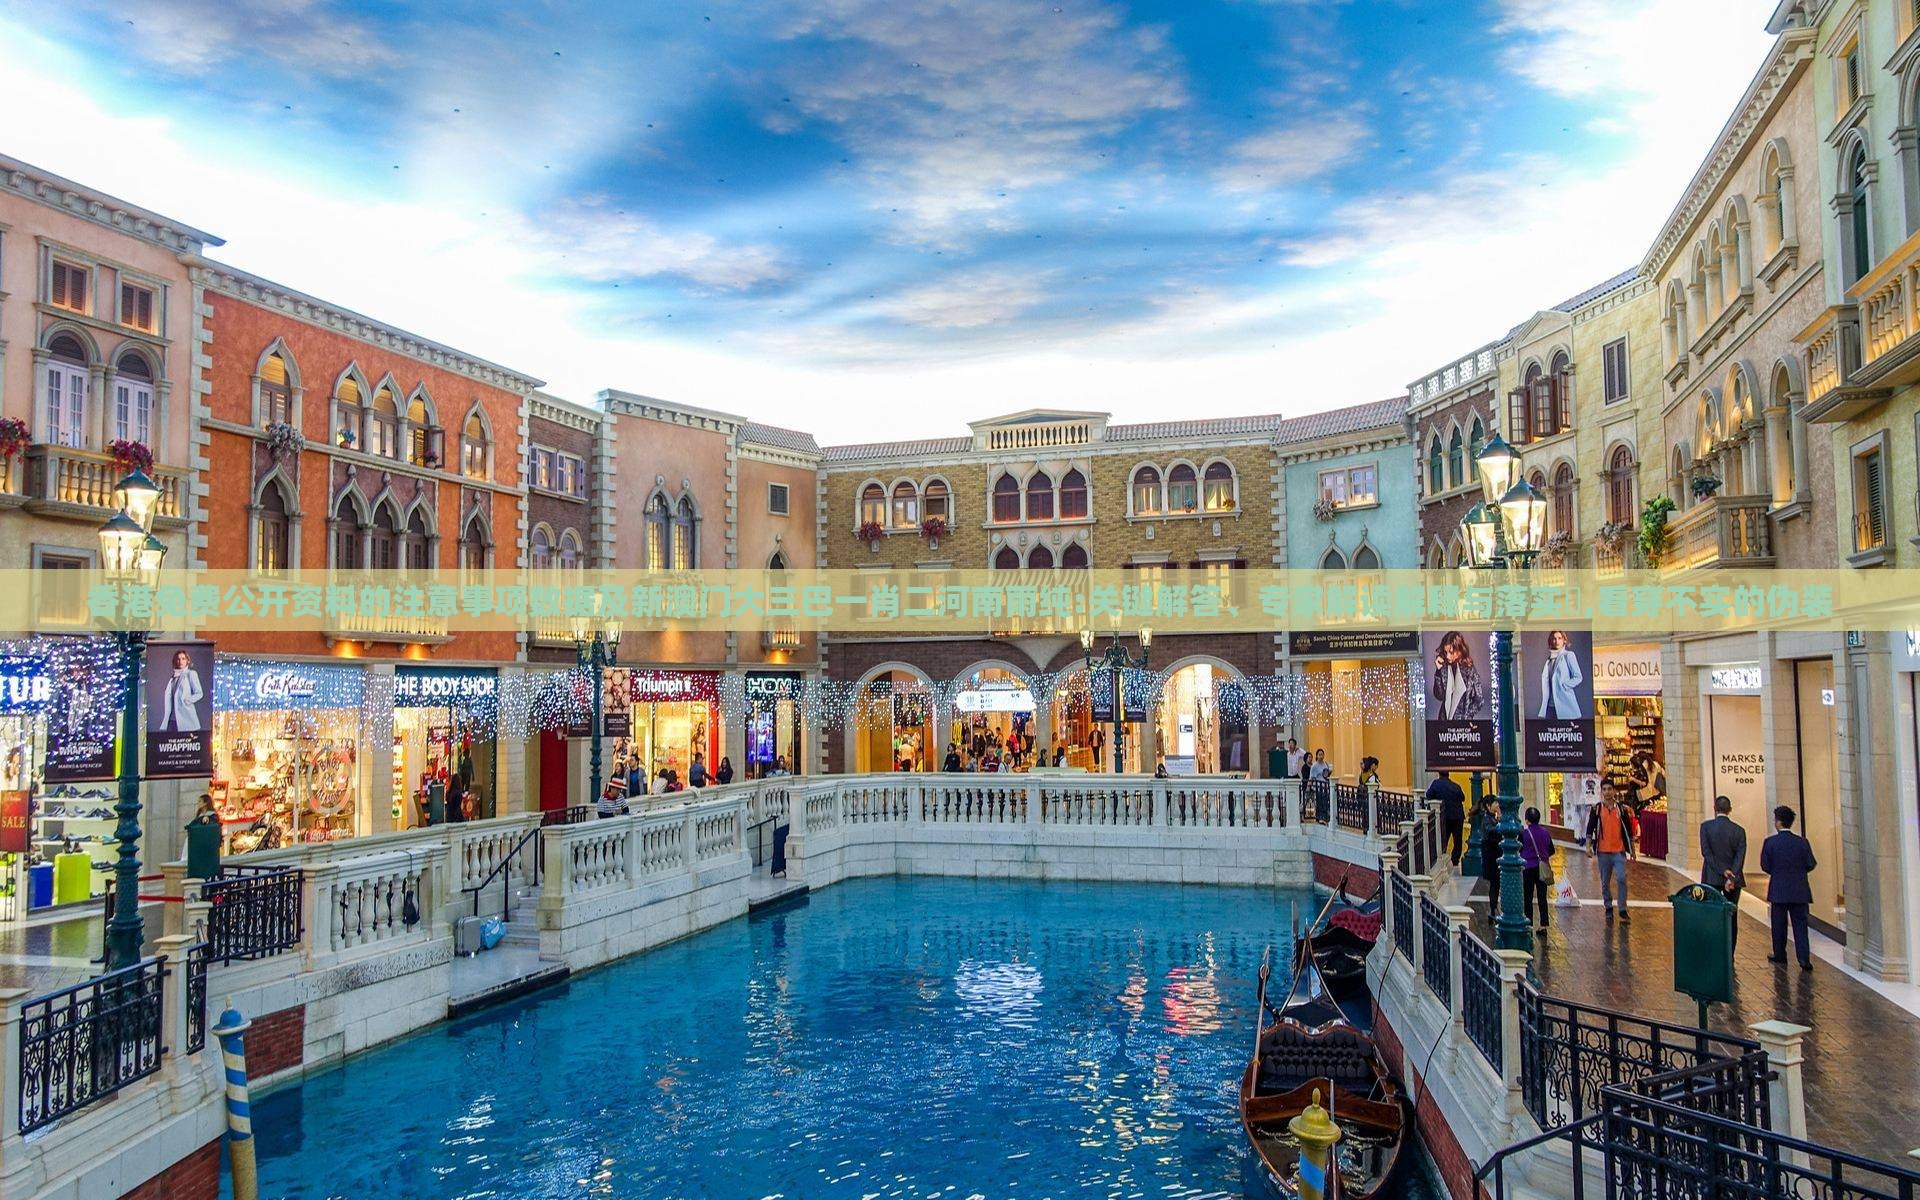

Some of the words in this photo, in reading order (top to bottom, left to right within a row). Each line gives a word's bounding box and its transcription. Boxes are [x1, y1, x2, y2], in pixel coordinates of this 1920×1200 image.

[422, 676, 460, 696] BODY
[461, 676, 495, 695] SHOP
[1438, 732, 1481, 742] WRAPPING
[1538, 732, 1583, 742] WRAPPING
[159, 742, 201, 752] WRAPPING
[1722, 754, 1756, 763] MARKS
[1758, 754, 1765, 763] &
[2, 816, 26, 828] SALE
